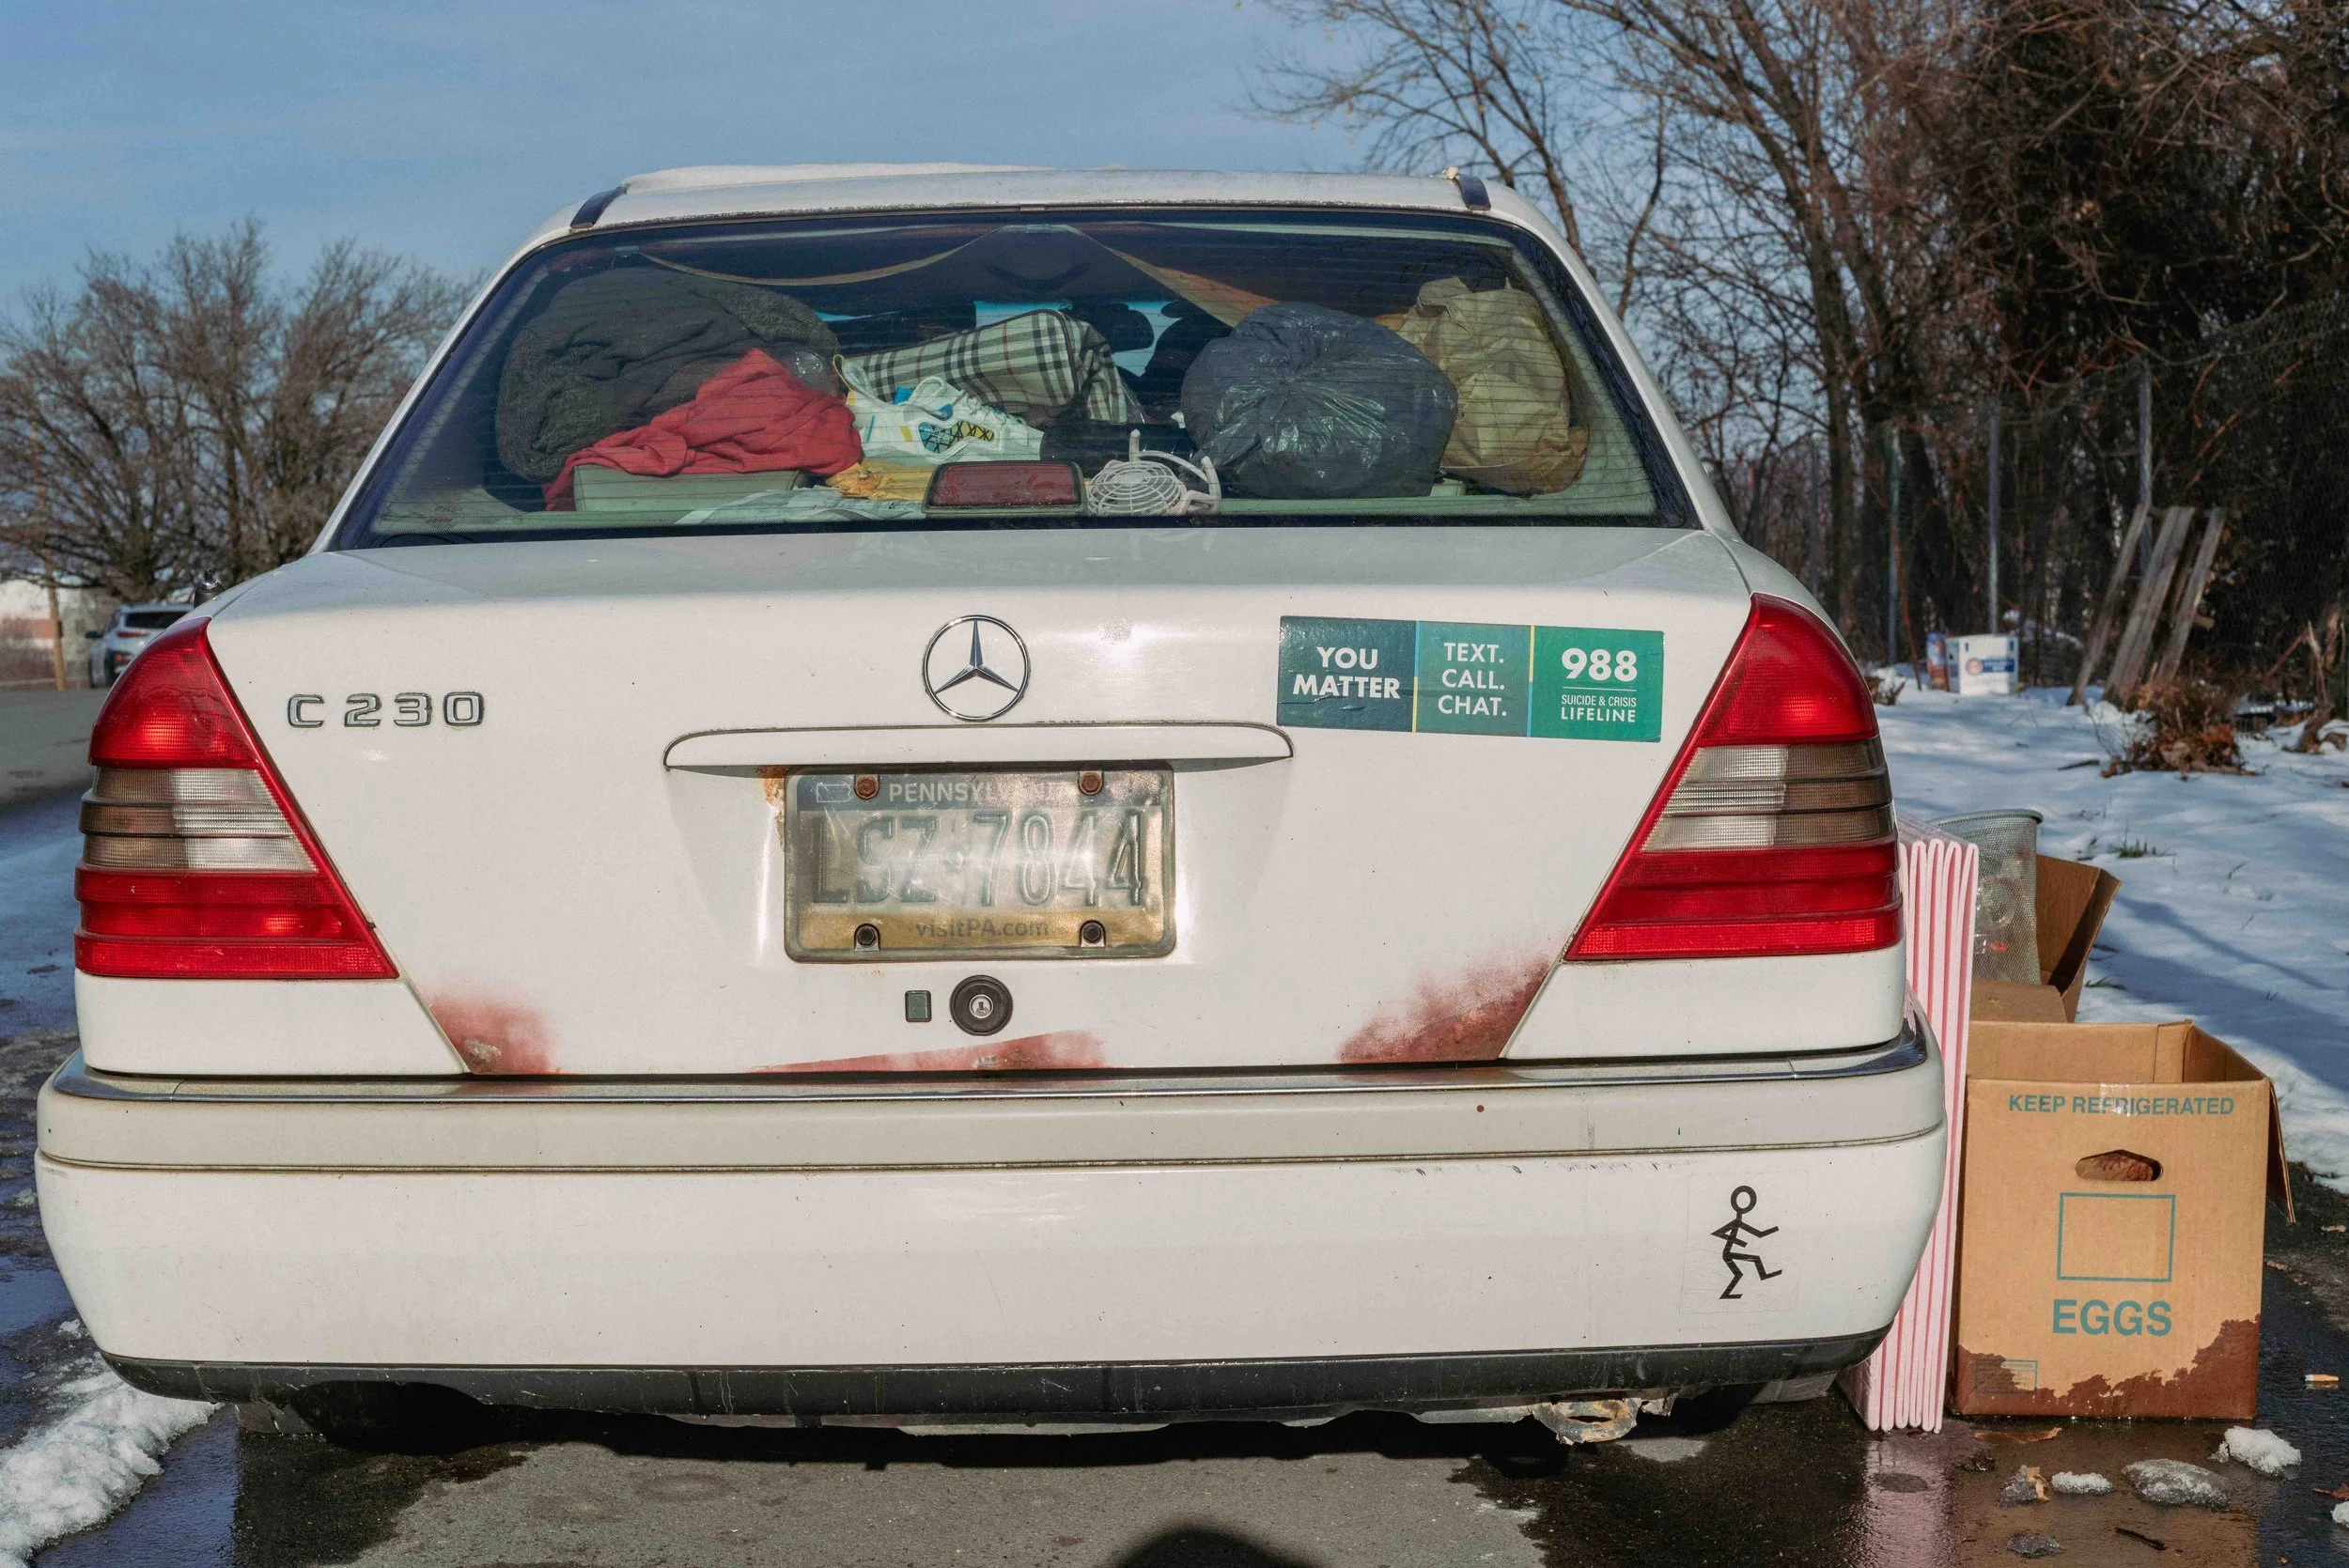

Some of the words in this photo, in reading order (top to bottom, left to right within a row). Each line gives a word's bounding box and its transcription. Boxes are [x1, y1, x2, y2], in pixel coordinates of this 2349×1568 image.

[1316, 646, 1378, 670] YOU
[1443, 642, 1504, 664] TEXT.
[1561, 647, 1638, 682] 988
[1292, 674, 1401, 700] MATTER
[1440, 668, 1505, 691] CALL.
[1438, 693, 1508, 717] CHAT.
[1561, 693, 1597, 706] SUICIDE
[1598, 695, 1606, 706] &
[1608, 696, 1637, 707] CRISIS
[1561, 706, 1636, 722] LIFELINE
[915, 918, 1050, 938] visitPA.com
[2008, 1094, 2066, 1113] KEEP
[2071, 1095, 2235, 1116] REFRIGERATED
[2051, 1297, 2173, 1337] EGGS
